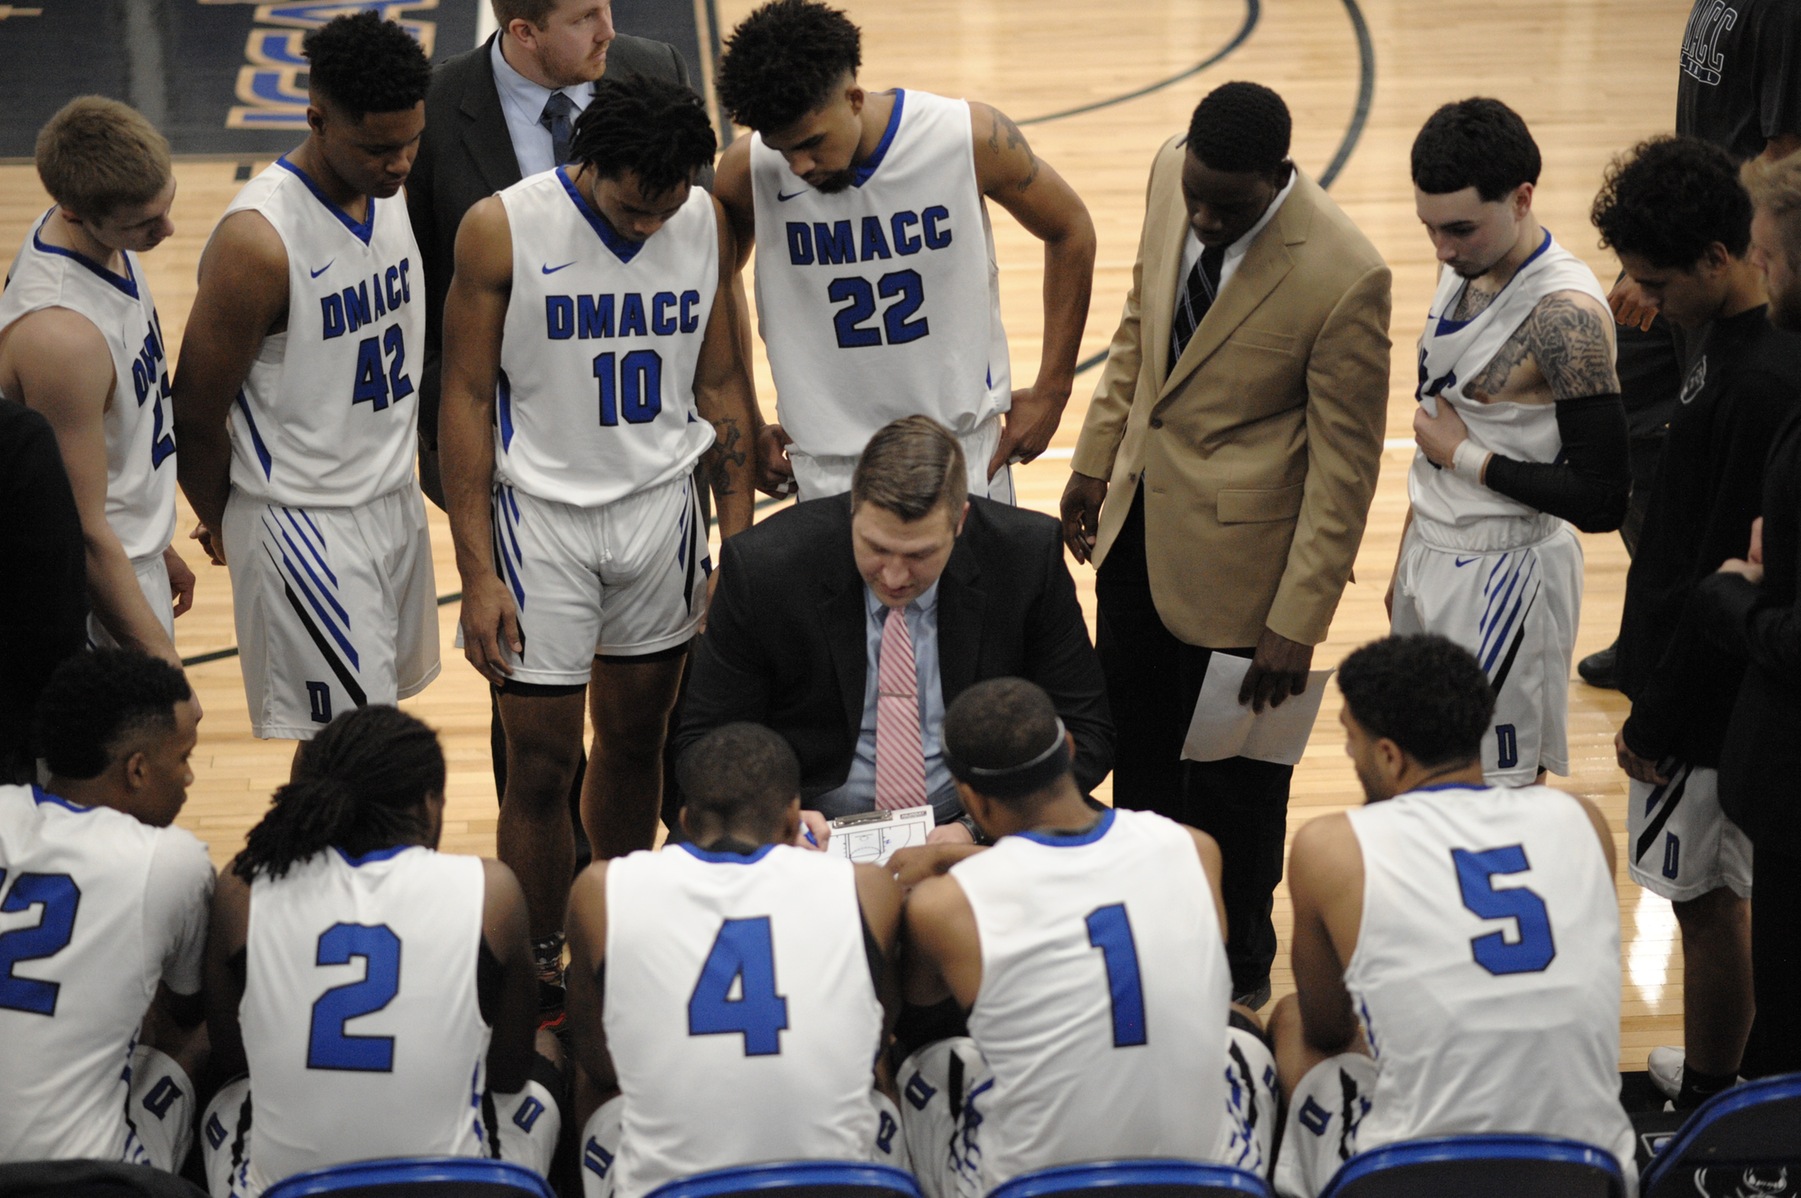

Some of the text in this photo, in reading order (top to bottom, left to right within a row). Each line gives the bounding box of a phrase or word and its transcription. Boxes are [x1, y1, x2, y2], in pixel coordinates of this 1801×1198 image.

[785, 204, 953, 266] DMACC
[321, 258, 411, 340] DMACC
[545, 289, 700, 340] DMACC
[827, 268, 930, 349] 22
[352, 323, 415, 413] 42
[592, 348, 663, 428] 10
[305, 680, 332, 724] D
[1495, 723, 1518, 769] D
[1662, 831, 1680, 880] D
[0, 867, 82, 1018] 2
[1450, 844, 1557, 976] 5
[305, 921, 402, 1074] 2
[687, 915, 789, 1057] 4
[1085, 901, 1148, 1049] 1
[142, 1075, 183, 1121] D
[512, 1096, 546, 1134] D
